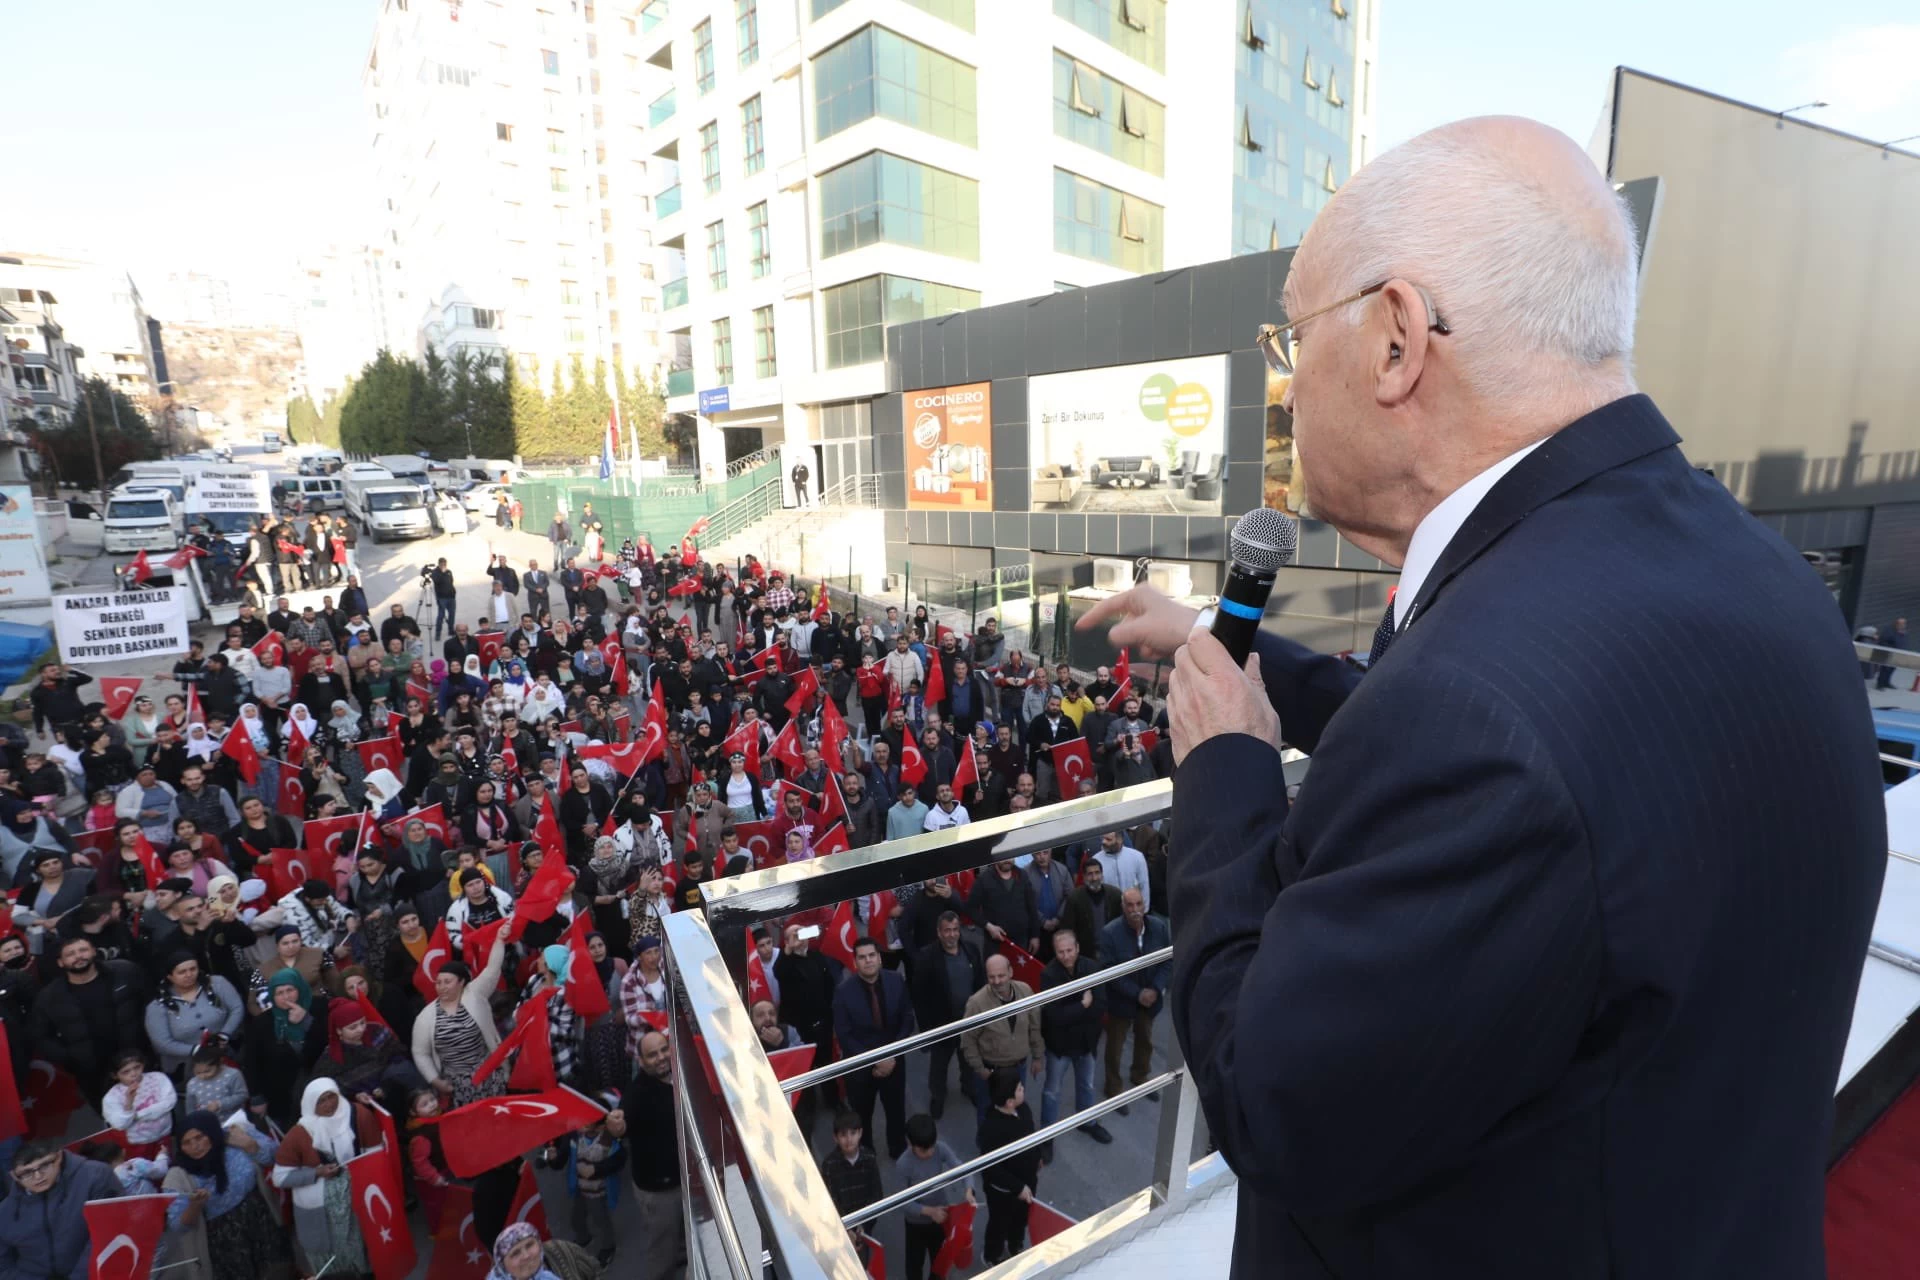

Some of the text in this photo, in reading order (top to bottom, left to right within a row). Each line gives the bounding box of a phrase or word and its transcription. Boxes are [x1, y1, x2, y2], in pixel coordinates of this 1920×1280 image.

[914, 391, 984, 409] COCINERO
[1061, 412, 1071, 422] Bir
[65, 591, 171, 610] ANKARA ROMANLAR
[100, 608, 145, 624] DERNEĞİ
[84, 623, 165, 641] SENİNLE GURUR
[69, 637, 178, 658] DUYUYOR BAŞKANIM
